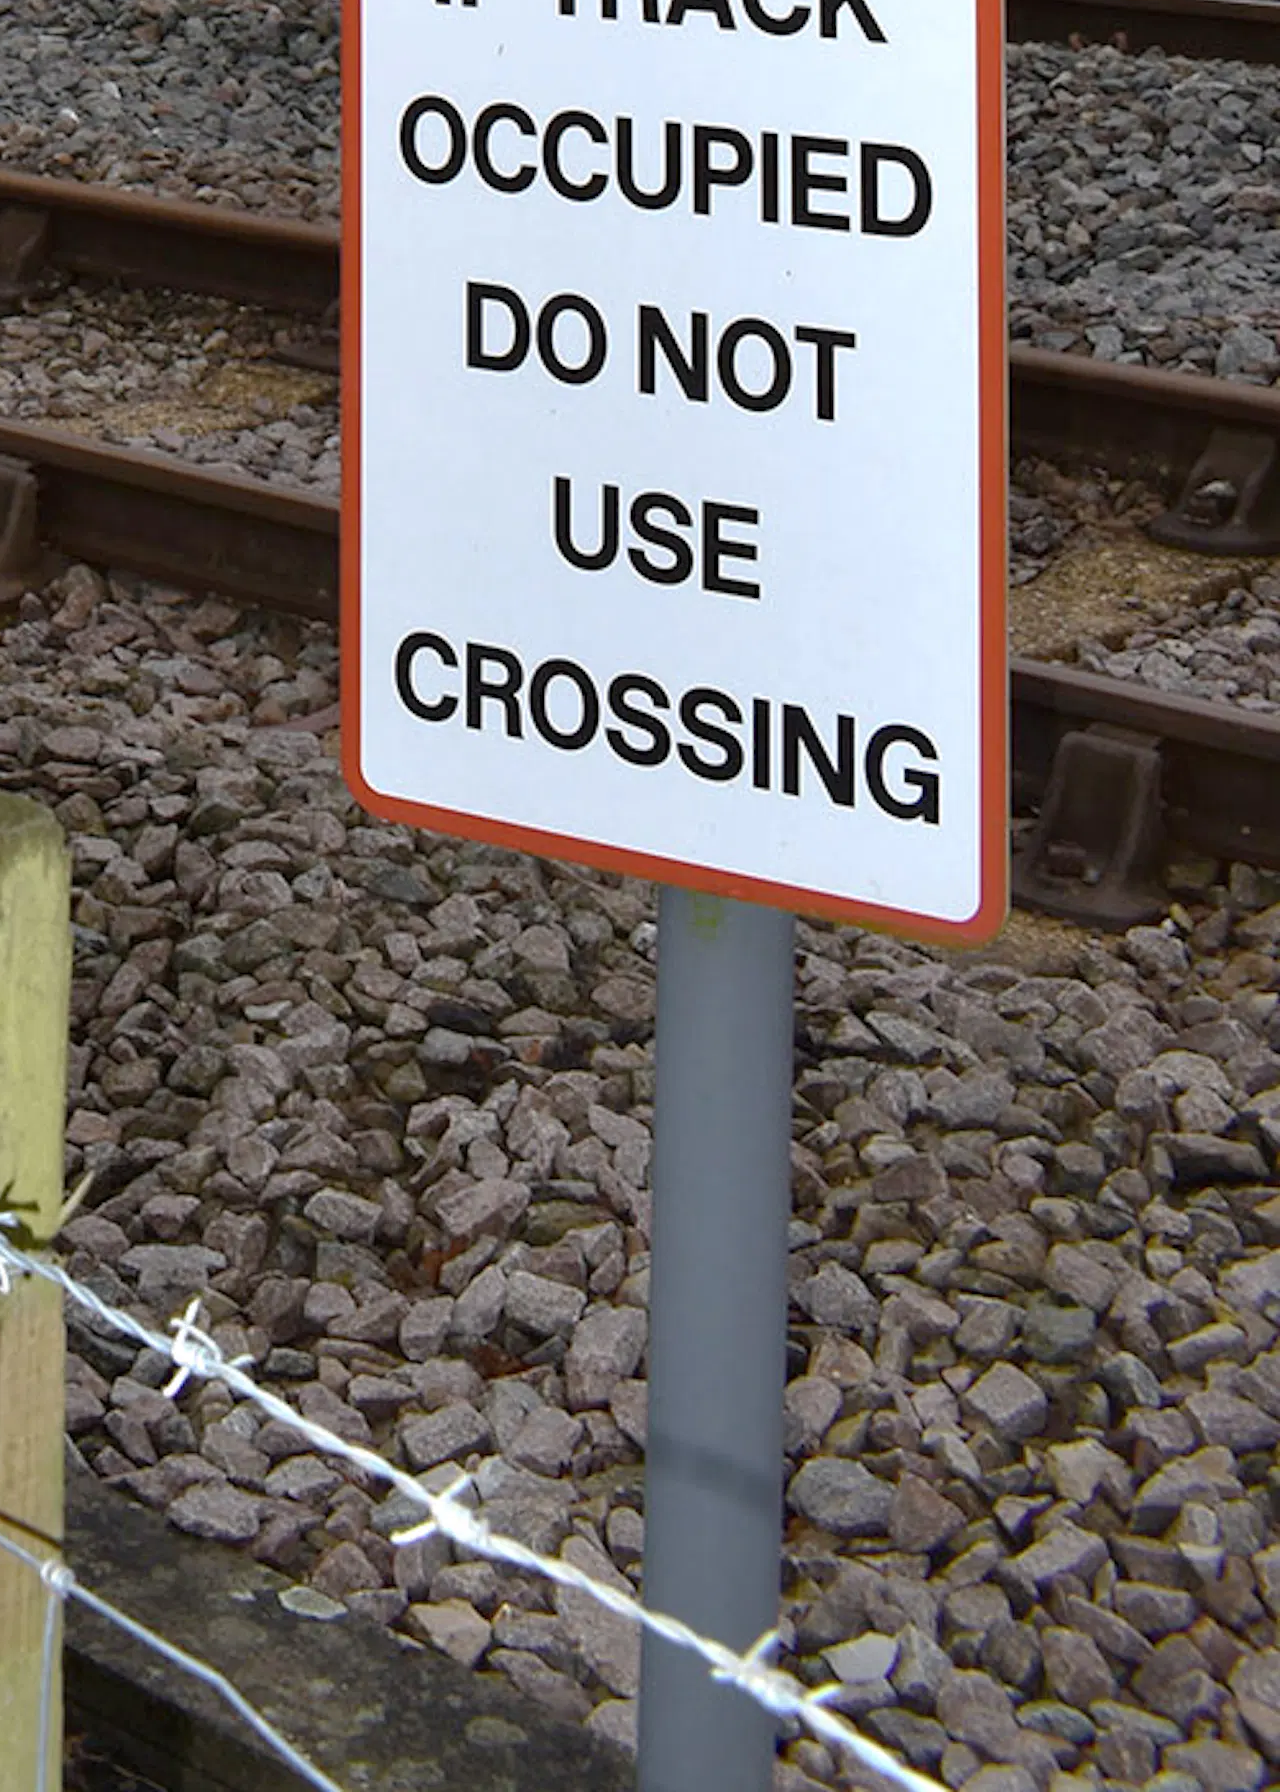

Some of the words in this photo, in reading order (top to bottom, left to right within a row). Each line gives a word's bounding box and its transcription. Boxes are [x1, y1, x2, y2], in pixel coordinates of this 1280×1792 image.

[398, 94, 933, 239] OCCUPIED
[465, 280, 608, 386] DO
[638, 303, 857, 422] NOT
[554, 475, 761, 600] USE
[394, 631, 940, 826] CROSSING
